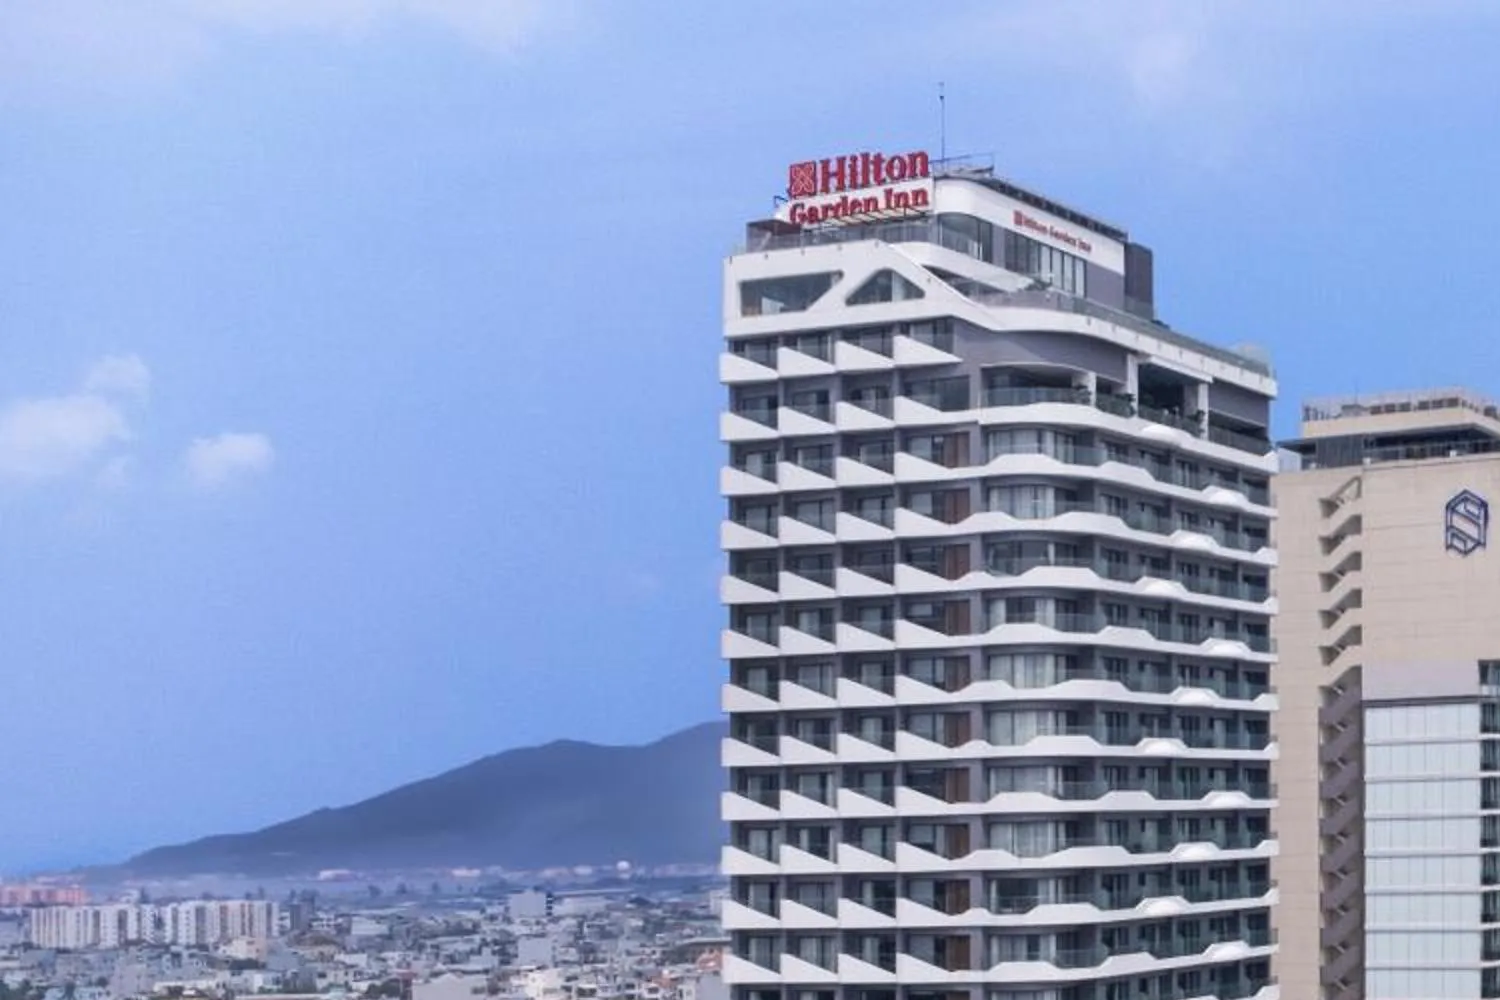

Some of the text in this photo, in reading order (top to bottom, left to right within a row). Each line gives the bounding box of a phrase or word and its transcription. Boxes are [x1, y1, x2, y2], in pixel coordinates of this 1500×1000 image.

[820, 151, 930, 194] Hilton
[789, 187, 930, 225] Garden Inn
